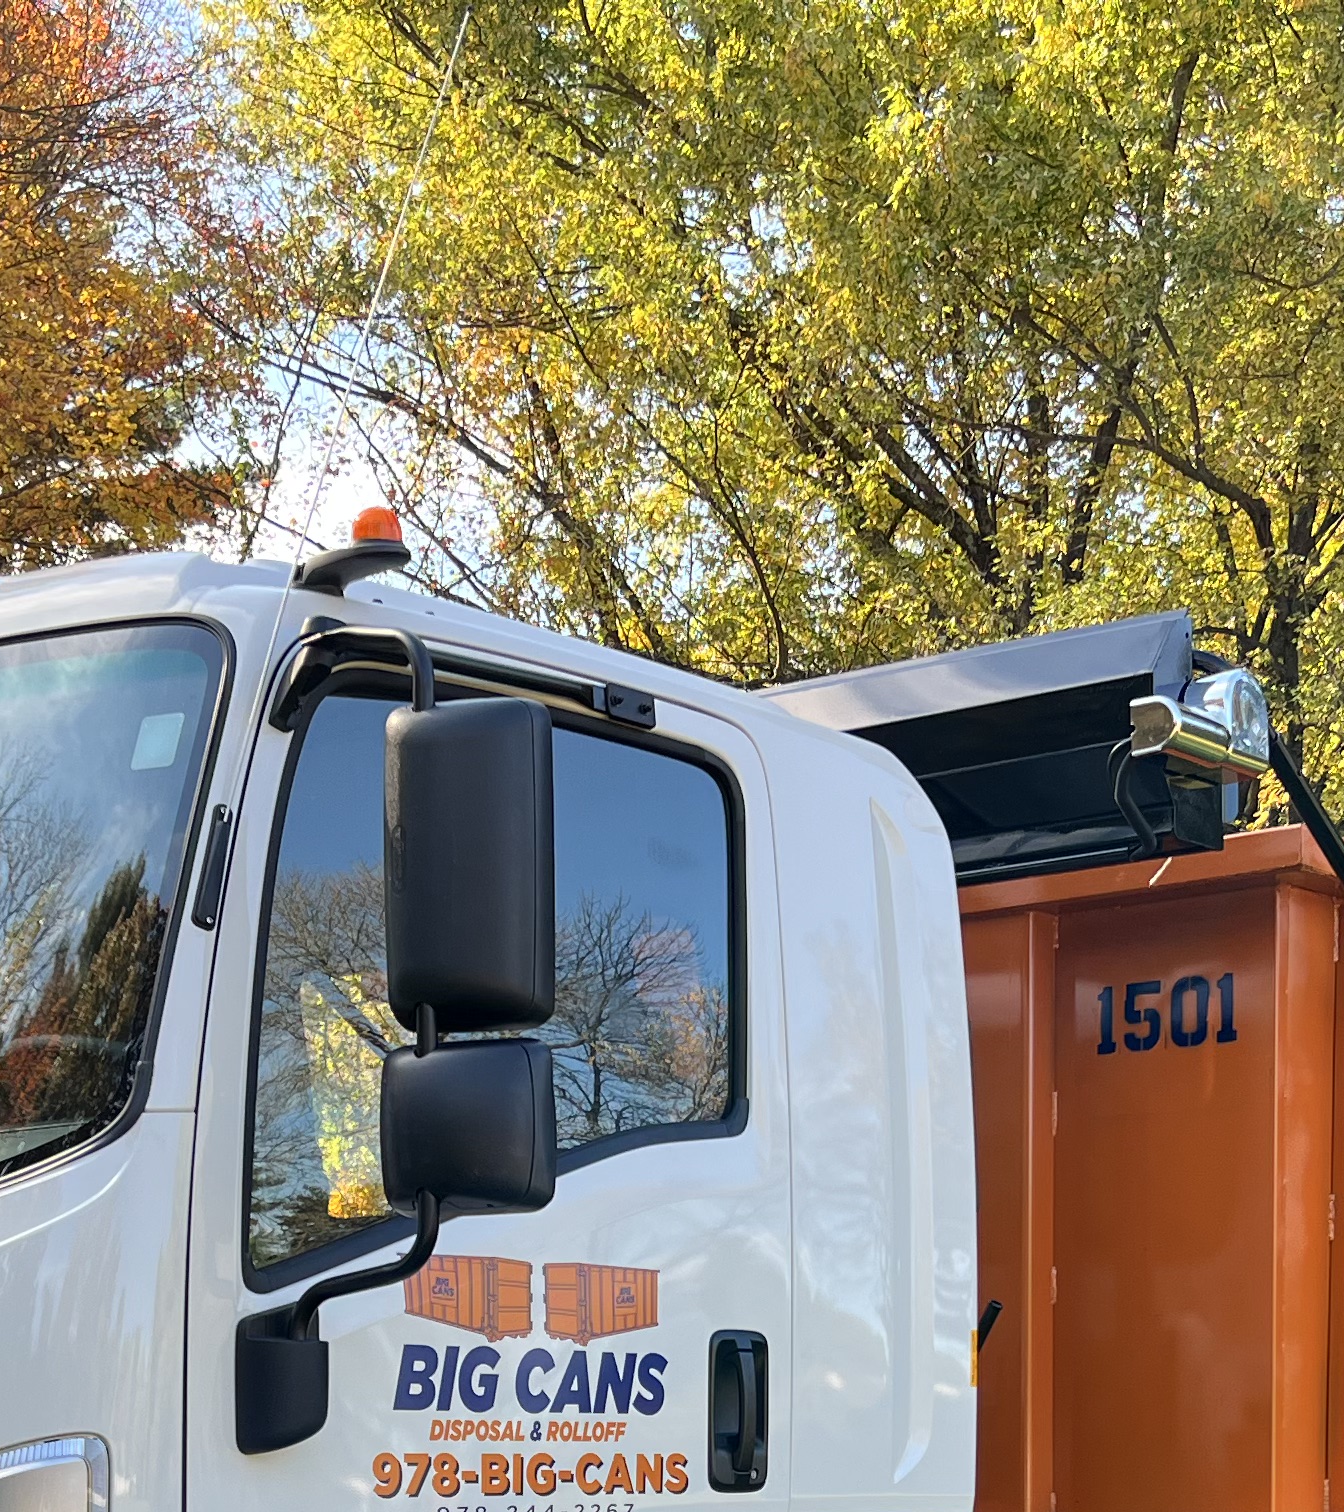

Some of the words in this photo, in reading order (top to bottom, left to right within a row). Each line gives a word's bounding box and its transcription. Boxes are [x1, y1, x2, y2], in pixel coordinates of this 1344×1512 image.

[1097, 972, 1238, 1055] 1501
[393, 1344, 501, 1413] BIG
[515, 1347, 669, 1416] CANS
[429, 1419, 526, 1442] DISPOSAL
[529, 1420, 542, 1442] &
[545, 1421, 627, 1443] ROLLOFF
[372, 1452, 690, 1499] 978-BIG-CANS
